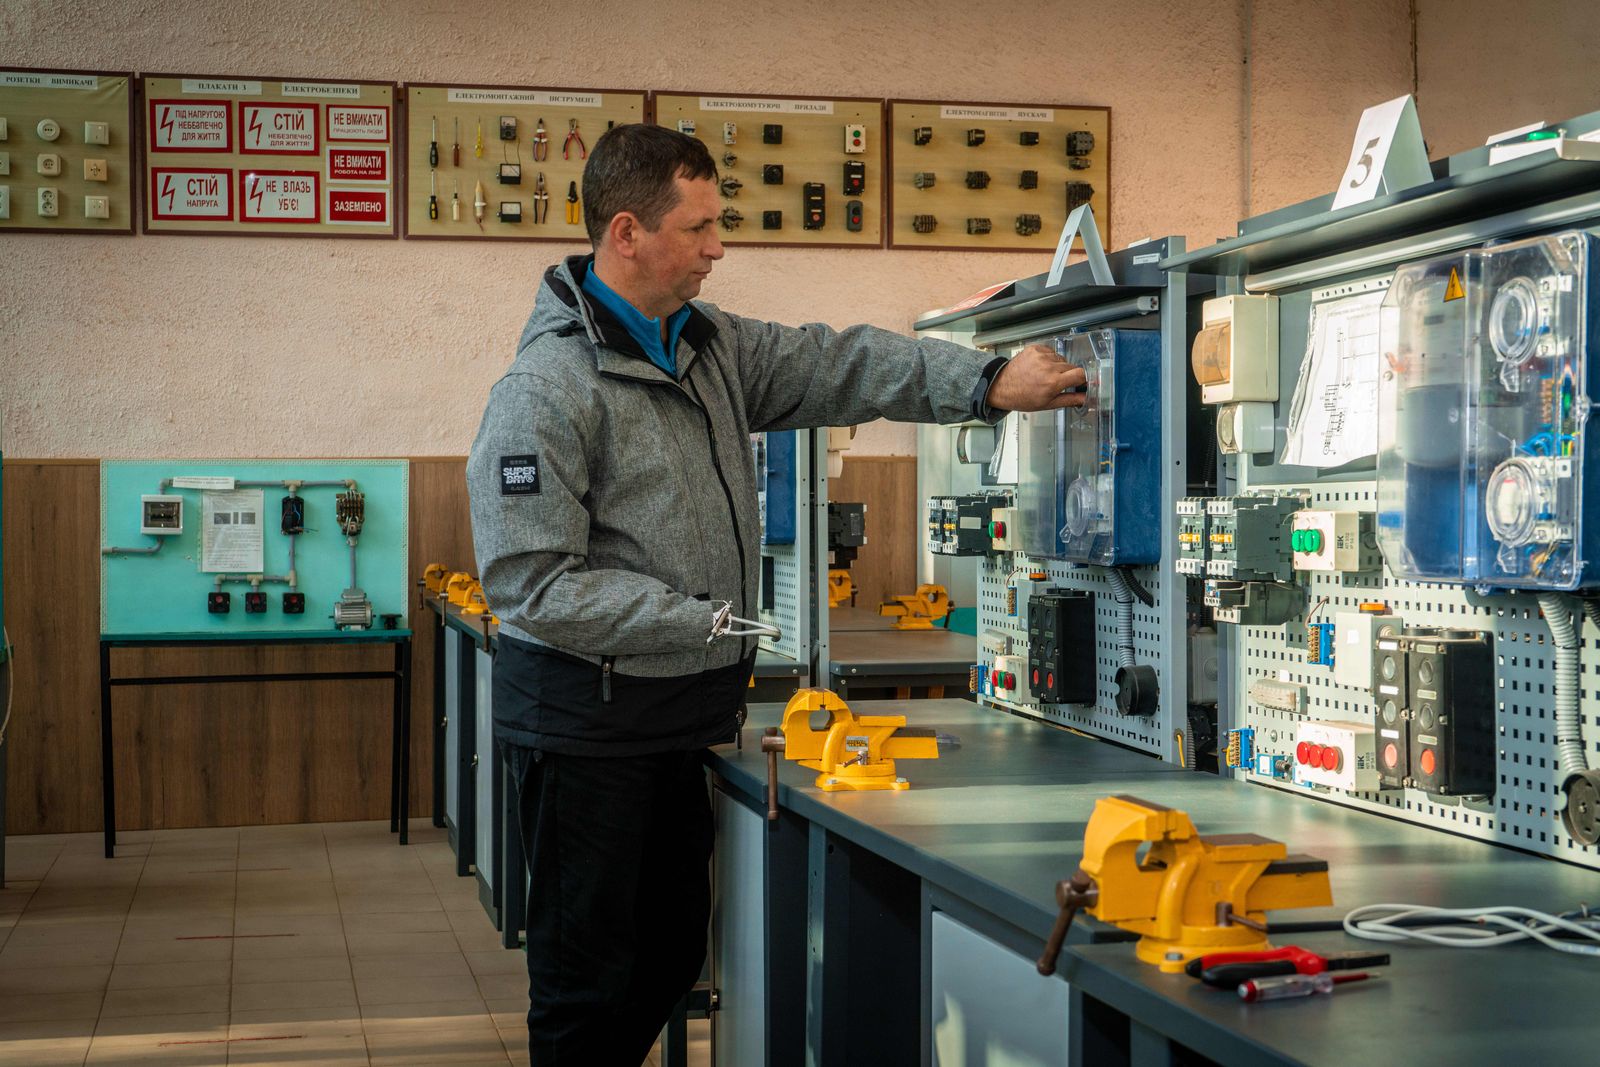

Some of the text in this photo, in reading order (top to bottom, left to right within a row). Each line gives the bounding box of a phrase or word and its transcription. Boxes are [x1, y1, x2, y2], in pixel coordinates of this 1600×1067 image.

[198, 83, 238, 91] ПЛАКАТИ
[284, 85, 358, 95] ЕЛЕКТРОБЕЗПЕКИ
[175, 109, 226, 119] ПІД НАПРУГОЮ
[274, 110, 305, 131] СТІЙ
[333, 112, 383, 127] НЕ ВМИКАТИ
[178, 121, 224, 130] НЕБЕЗПЕЧНО
[182, 132, 220, 142] ДЛЯ ЖИТТЯ
[334, 154, 382, 169] НЕ ВМИКАТИ
[1349, 136, 1381, 189] 5
[186, 175, 218, 196] СТІЙ
[265, 180, 311, 194] НЕ ВЛАЗЬ
[186, 199, 219, 208] НАПРУГА
[334, 200, 382, 213] ЗАЗЕМЛЕНО
[503, 466, 535, 476] SUPER
[1336, 535, 1344, 549] IEK
